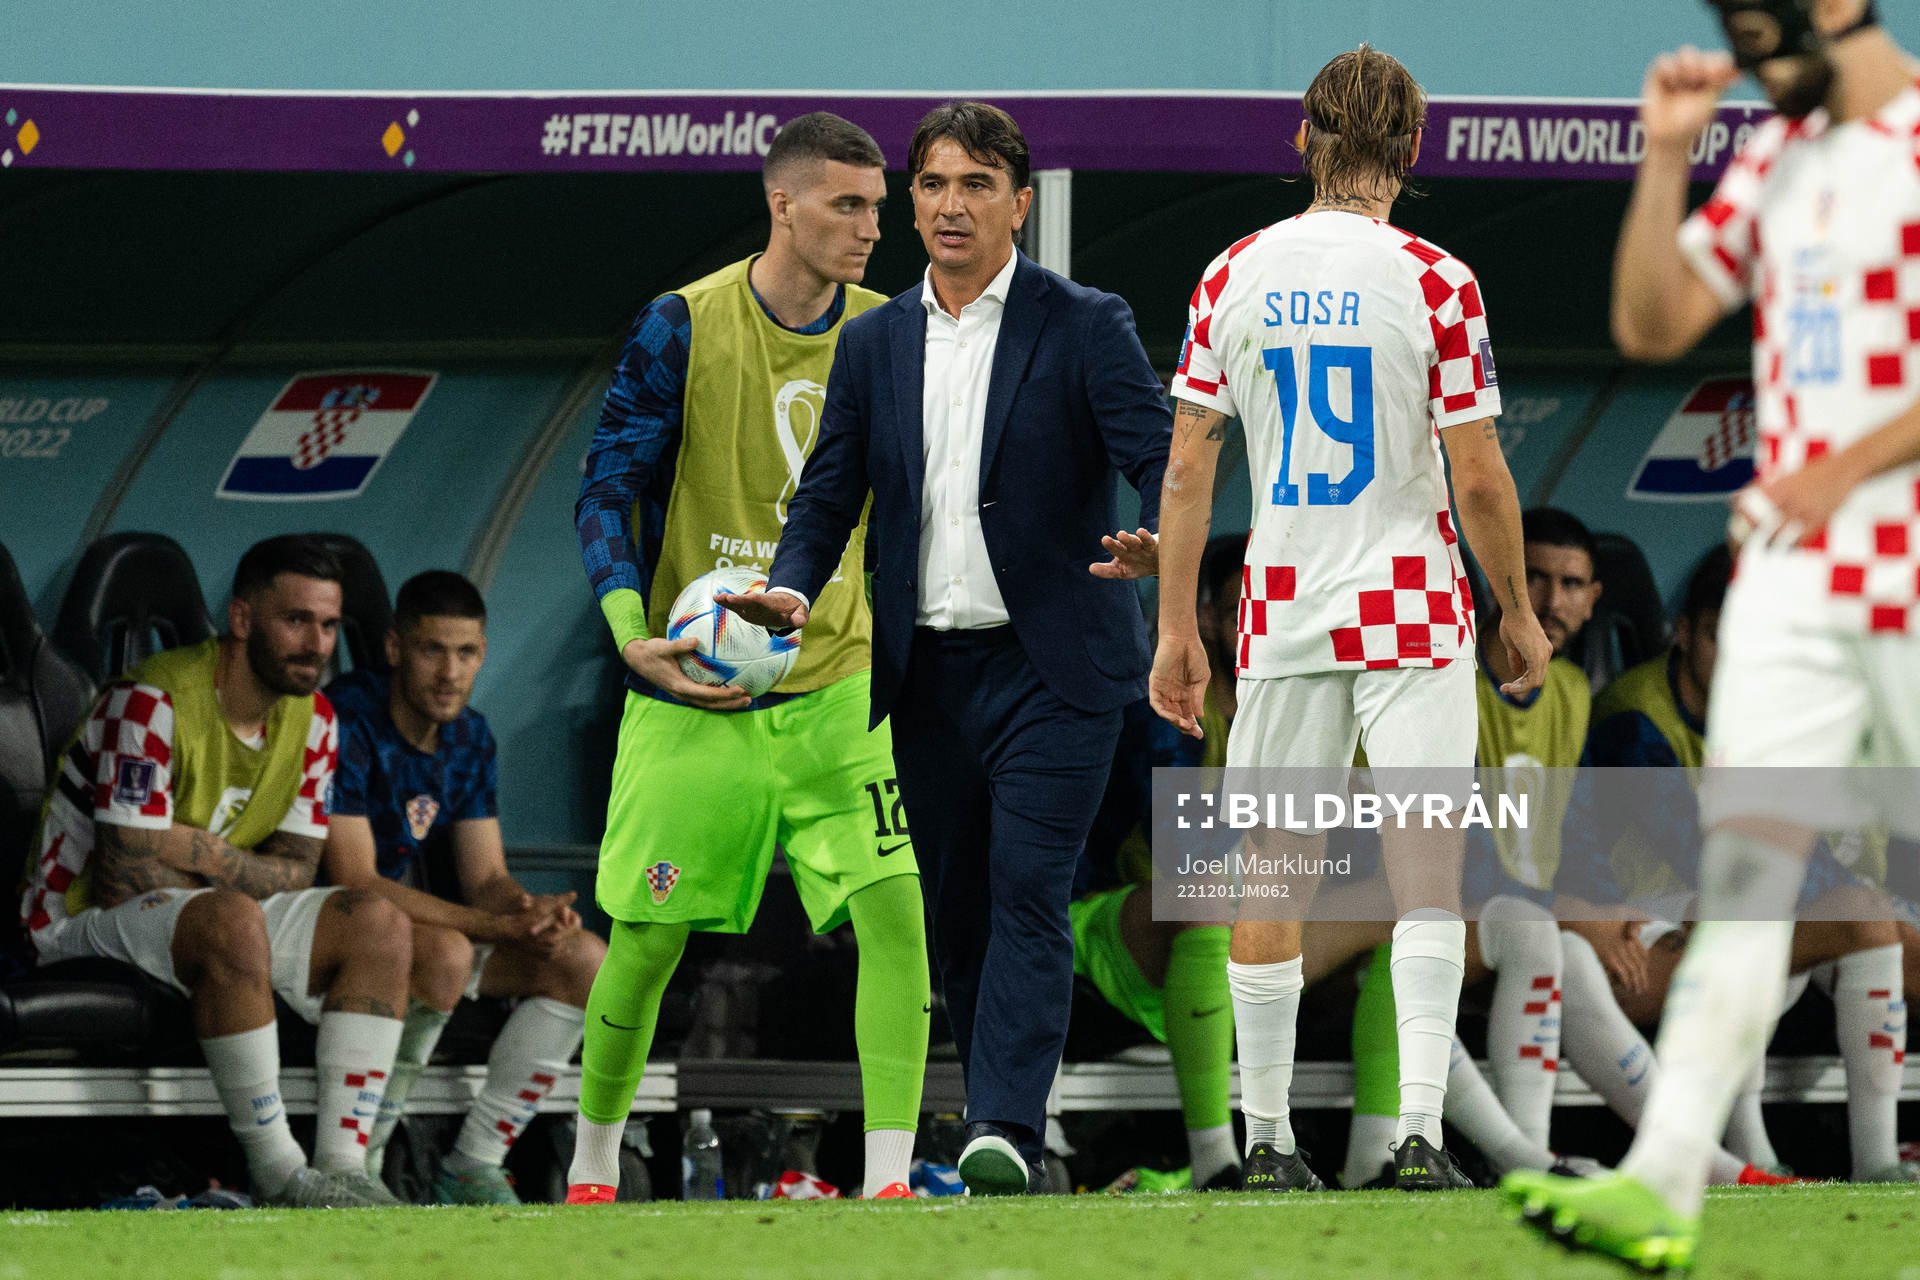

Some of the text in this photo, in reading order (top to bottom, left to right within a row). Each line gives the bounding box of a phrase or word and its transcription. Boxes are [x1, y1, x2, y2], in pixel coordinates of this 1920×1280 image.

[541, 111, 782, 156] #FIFAWorldC
[1446, 116, 1523, 162] FIFA
[1527, 118, 1648, 164] WORLD
[1263, 290, 1360, 327] SOSA
[47, 398, 109, 423] CUP
[1262, 344, 1375, 507] 19
[709, 533, 753, 557] FIFA
[864, 778, 910, 837] 12
[1247, 1173, 1276, 1184] COPA
[1399, 1166, 1429, 1177] COPA
